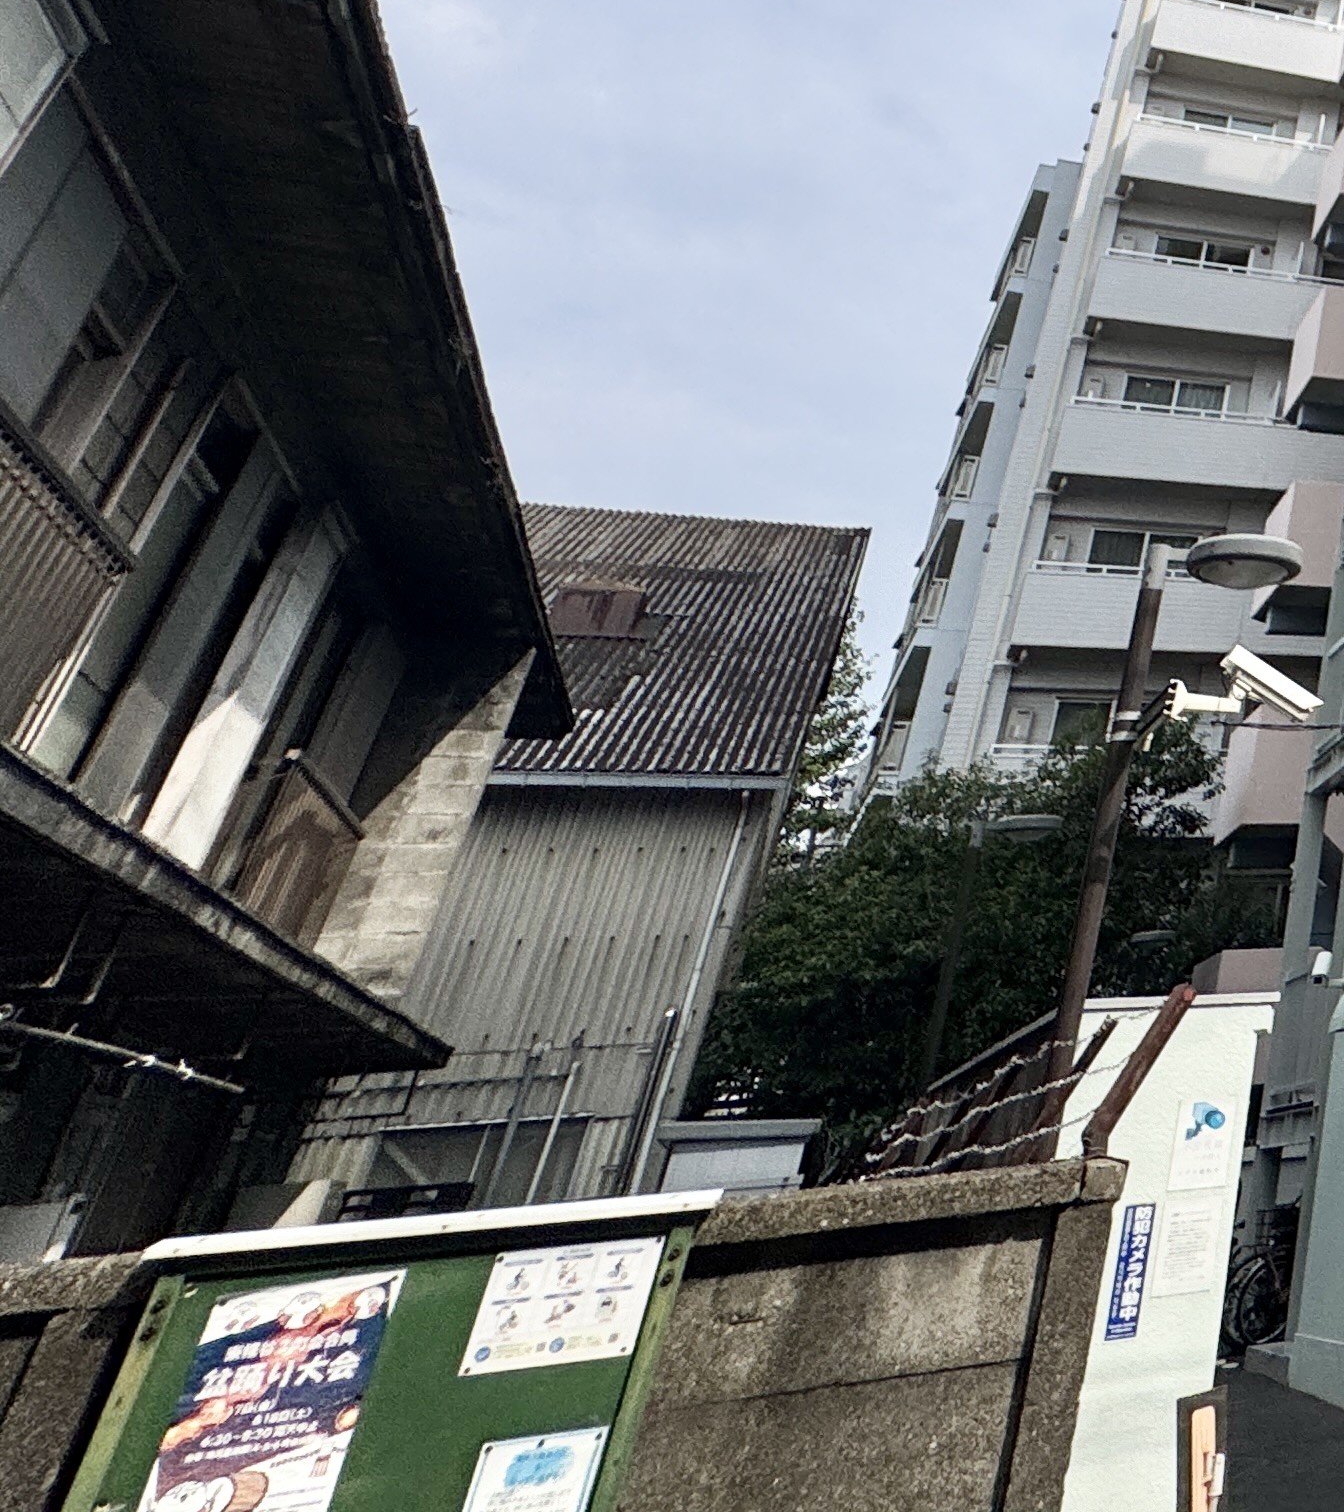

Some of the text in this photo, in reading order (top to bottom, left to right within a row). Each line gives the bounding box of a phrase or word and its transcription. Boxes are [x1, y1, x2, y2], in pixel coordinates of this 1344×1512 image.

[1119, 1206, 1153, 1322] 防犯カメラ作動中
[193, 1351, 361, 1402] 盆踊り大会
